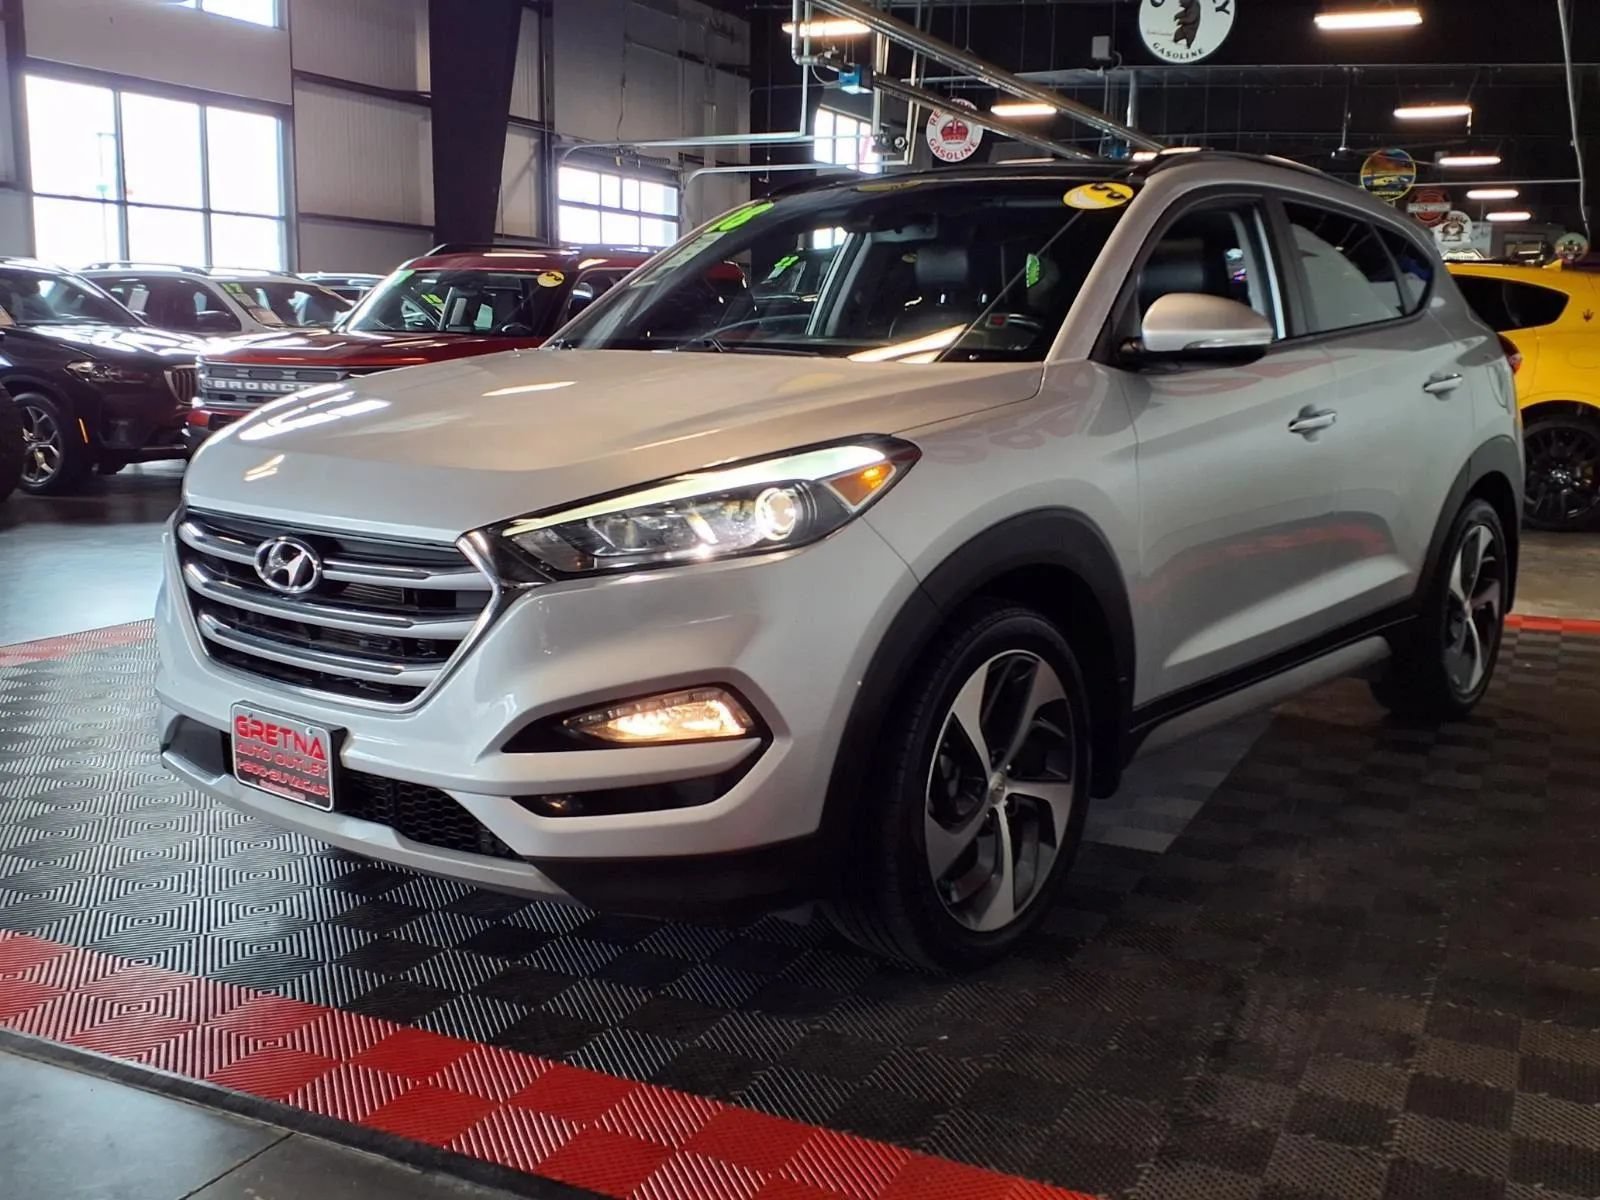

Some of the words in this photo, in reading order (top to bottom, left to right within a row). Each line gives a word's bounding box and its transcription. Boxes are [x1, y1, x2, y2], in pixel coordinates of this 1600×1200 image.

[1153, 42, 1204, 59] GASOLINE
[930, 138, 977, 160] GASOLINE
[236, 715, 327, 762] GRETNA
[237, 742, 272, 761] AUTO
[274, 752, 328, 779] OUTLET
